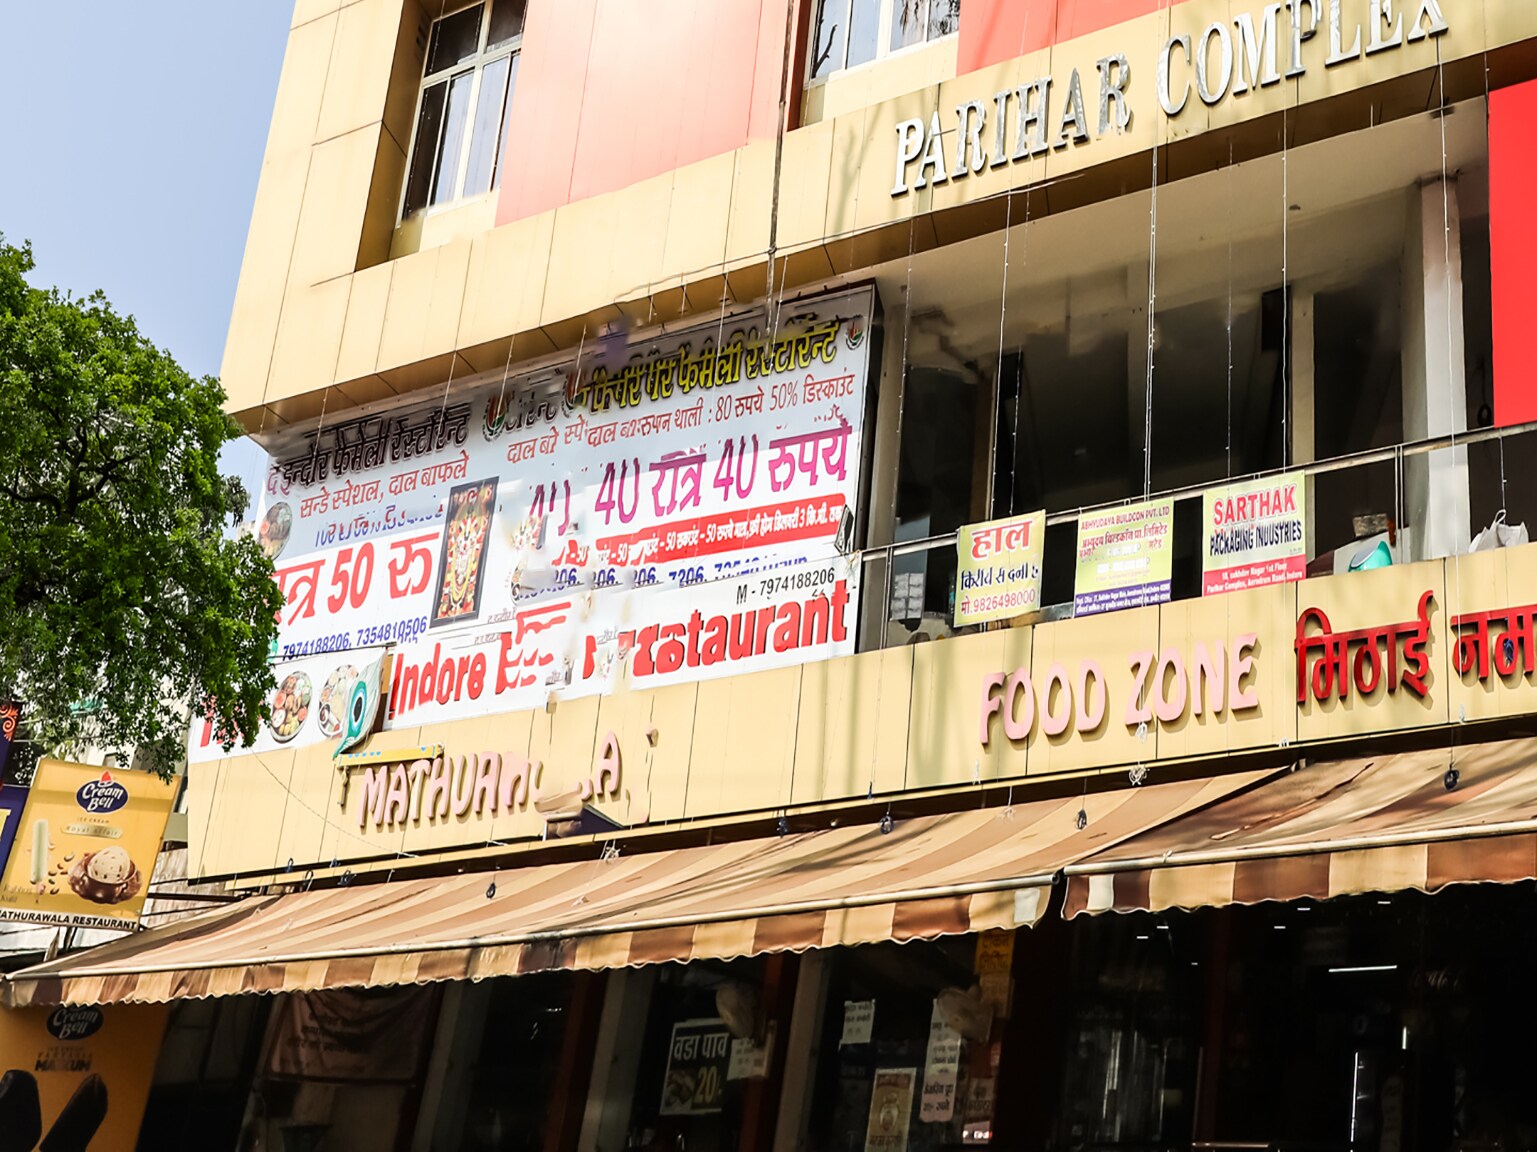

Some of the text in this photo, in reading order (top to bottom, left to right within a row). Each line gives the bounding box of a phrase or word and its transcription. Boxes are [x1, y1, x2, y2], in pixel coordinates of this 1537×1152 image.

[890, 53, 1131, 198] PARIHAR
[715, 395, 733, 422] 80
[769, 380, 798, 412] 50%
[389, 469, 419, 495] दाल
[421, 450, 470, 488] बाफले
[1214, 485, 1296, 525] SARTHAK
[706, 523, 716, 543] 50
[971, 520, 1033, 559] हाल
[1256, 520, 1302, 548] INDUSTRIES
[327, 542, 374, 614] 50
[736, 584, 747, 605] M
[760, 567, 835, 598] 7974188206
[1294, 589, 1435, 706] मिठाई
[980, 633, 1259, 745] FOOD ZONE
[82, 783, 124, 799] Cream
[87, 797, 114, 812] Bell
[72, 915, 137, 931] RESTAURANT
[53, 1008, 99, 1027] Cream
[59, 1021, 89, 1039] Bell
